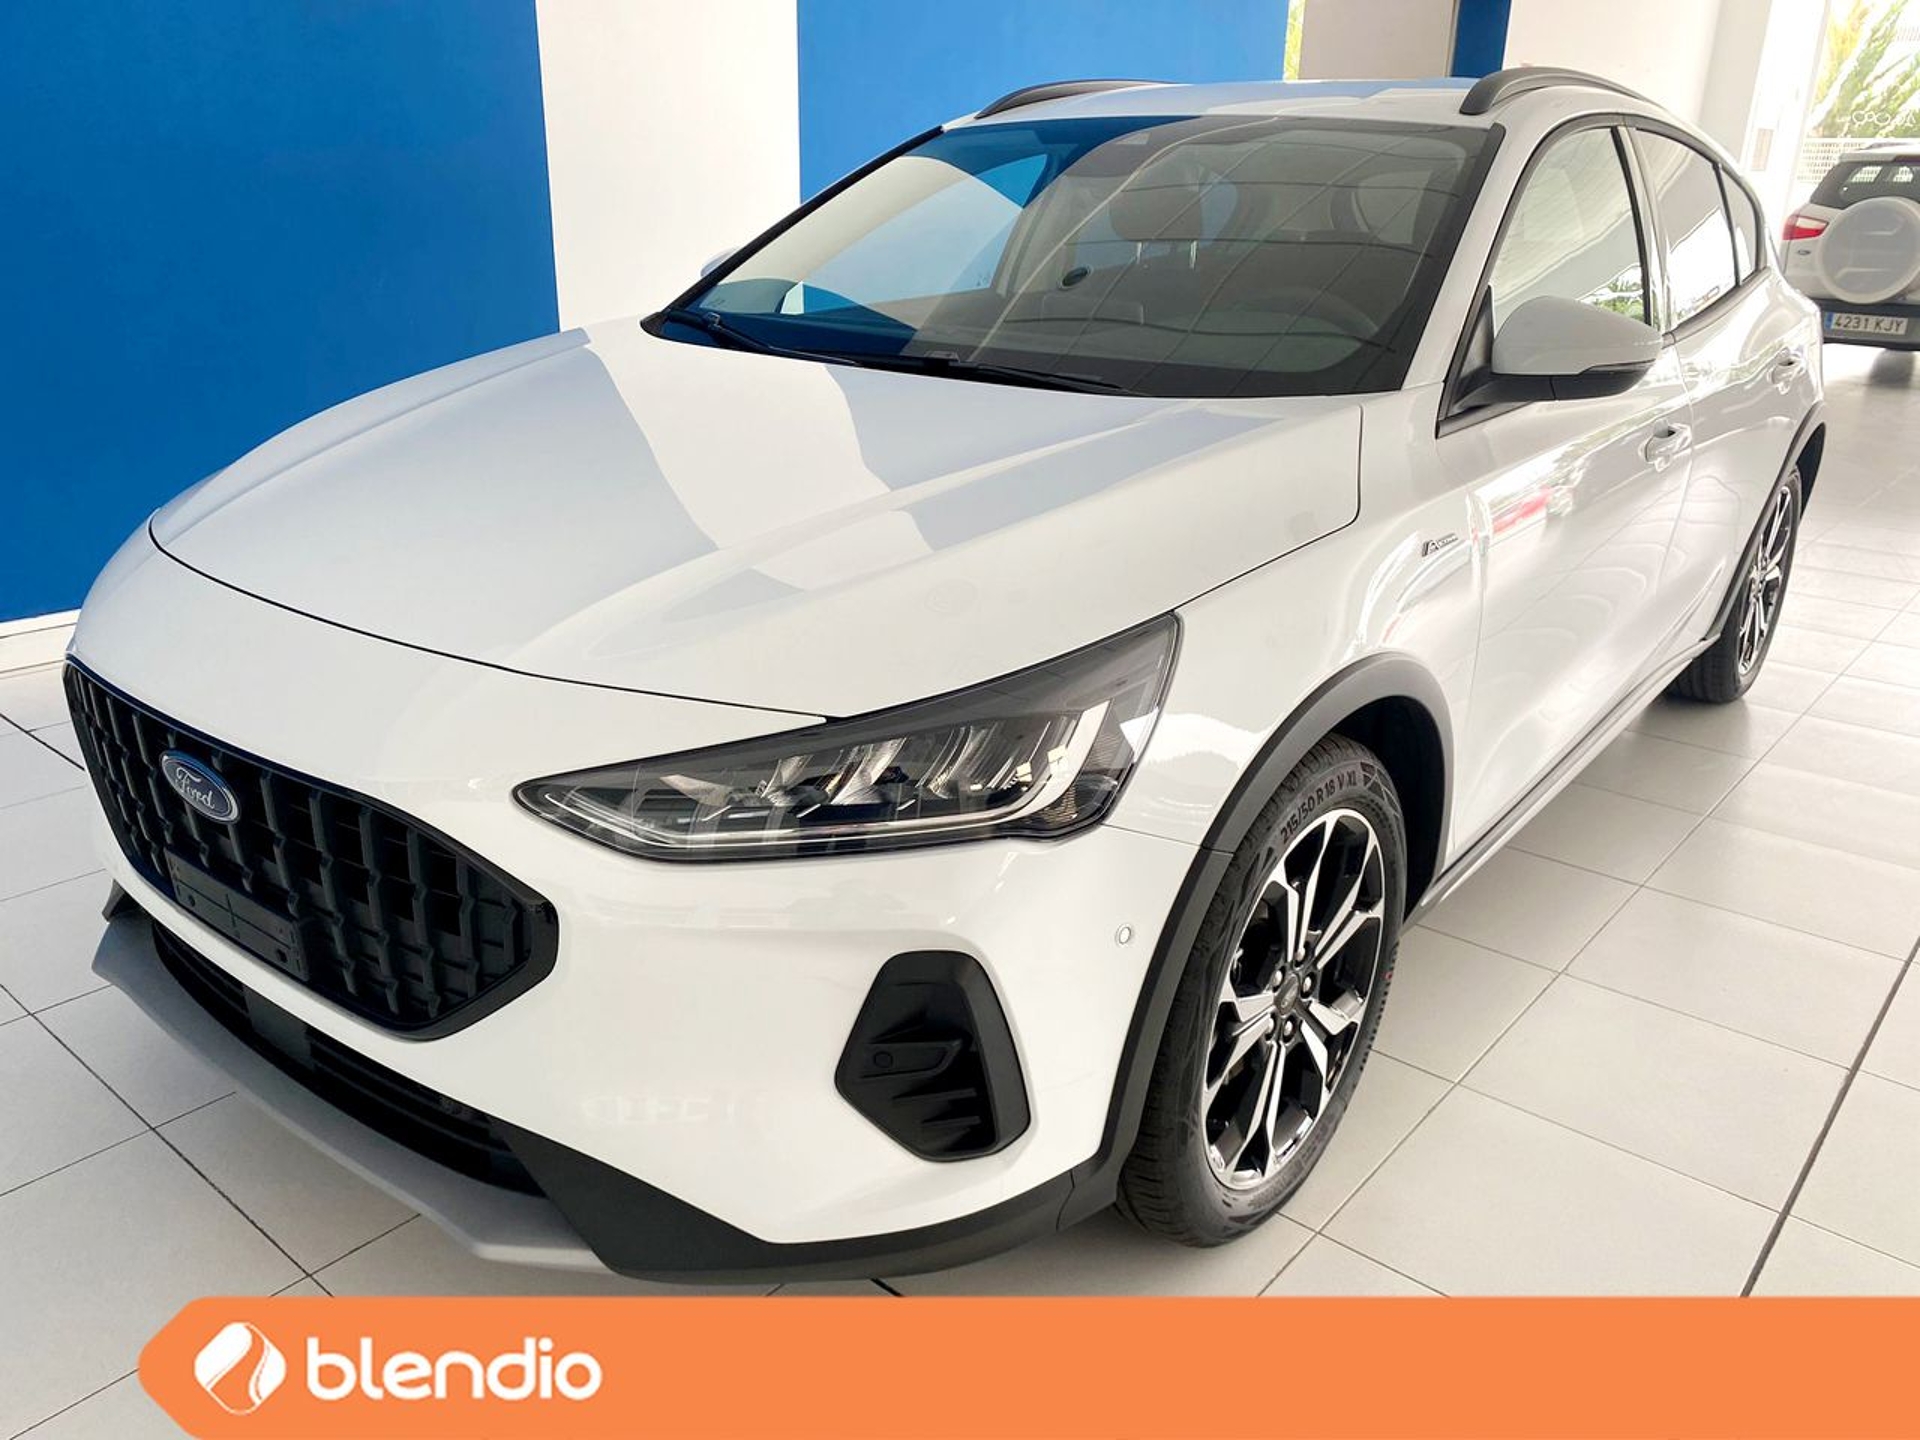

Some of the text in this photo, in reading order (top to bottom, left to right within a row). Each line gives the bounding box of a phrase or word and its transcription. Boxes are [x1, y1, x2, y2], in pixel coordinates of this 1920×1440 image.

[1834, 314, 1903, 333] 4231 KJY
[175, 766, 215, 809] Ford
[1280, 796, 1315, 845] 215/50
[1315, 787, 1325, 805] R
[1324, 778, 1337, 798] 18
[1337, 772, 1345, 791] V
